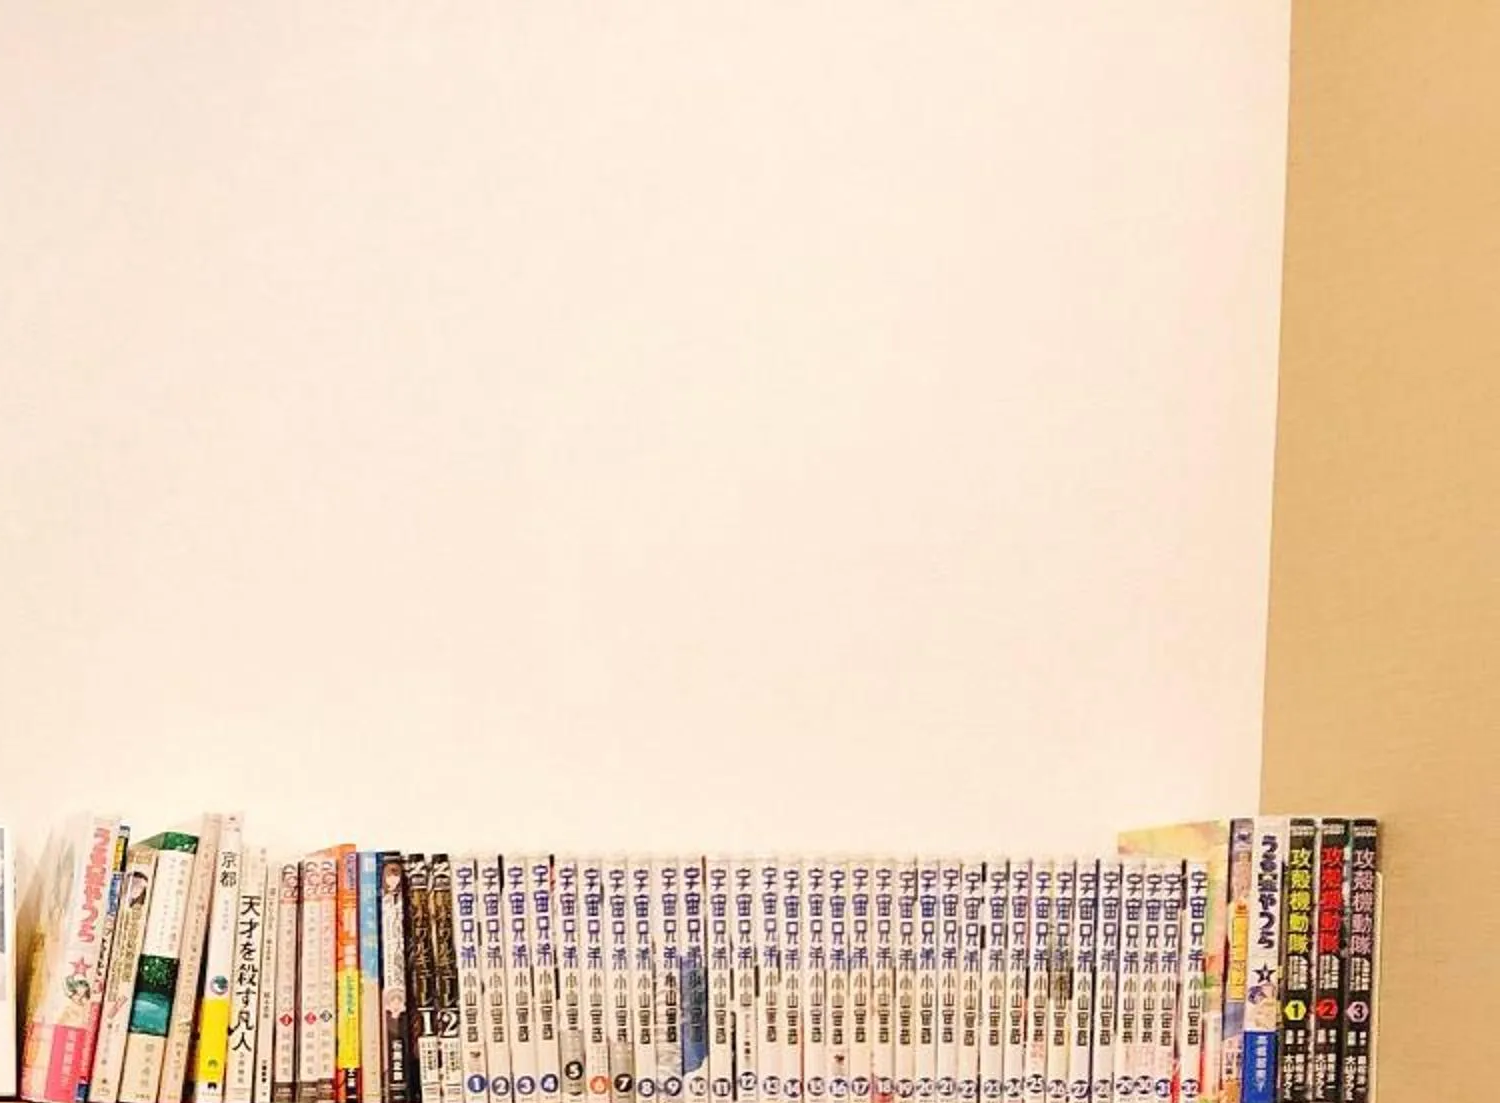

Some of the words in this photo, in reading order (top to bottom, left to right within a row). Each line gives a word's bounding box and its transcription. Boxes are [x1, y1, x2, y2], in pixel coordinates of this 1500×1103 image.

[220, 851, 238, 887] 京都
[1257, 835, 1278, 949] うる星やつら
[1289, 848, 1312, 953] 攻殻機動隊
[1350, 849, 1375, 953] 攻殻機動隊
[232, 895, 262, 1052] 天才を殺す凡人
[420, 1009, 435, 1035] 1
[439, 1010, 458, 1037] 2
